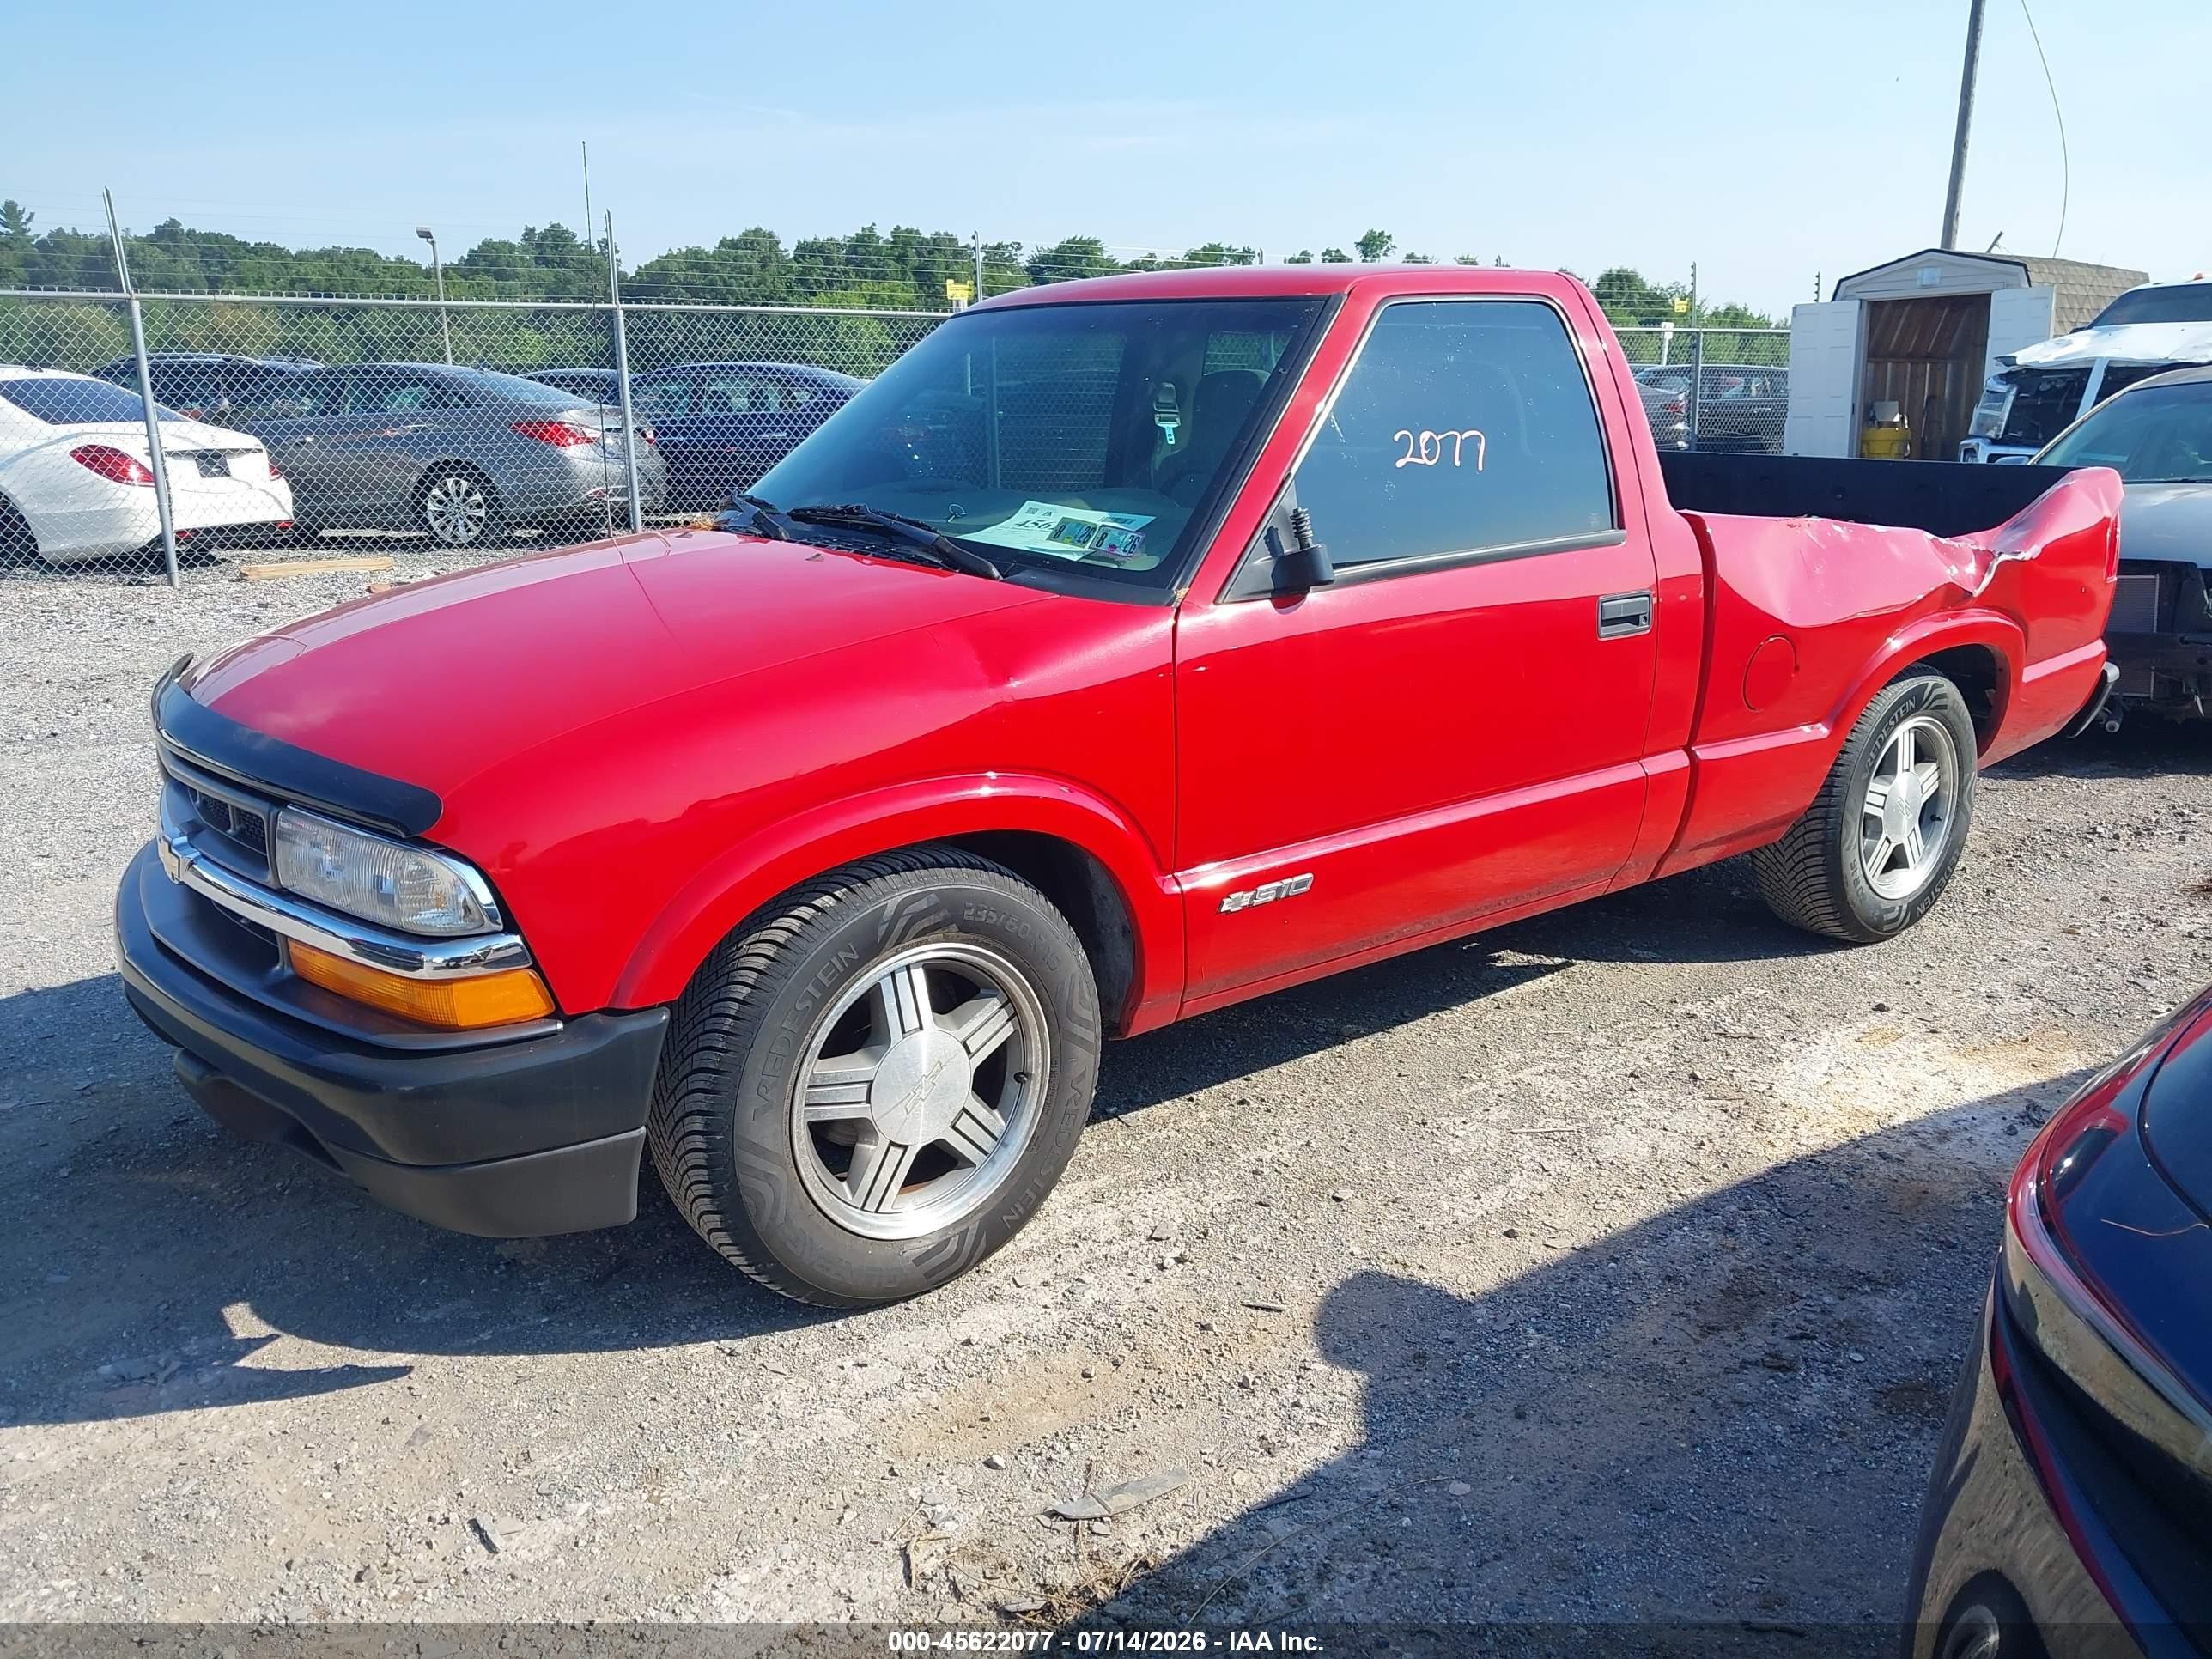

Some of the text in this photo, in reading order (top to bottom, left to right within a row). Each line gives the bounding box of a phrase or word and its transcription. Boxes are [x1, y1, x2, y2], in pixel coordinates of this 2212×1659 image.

[1393, 429, 1486, 471] 2077
[1053, 524, 1097, 544] 8 26
[1096, 532, 1141, 555] 8 26
[752, 942, 860, 1121] VREDESTEIN
[1002, 1066, 1086, 1230] VREDESTEIN
